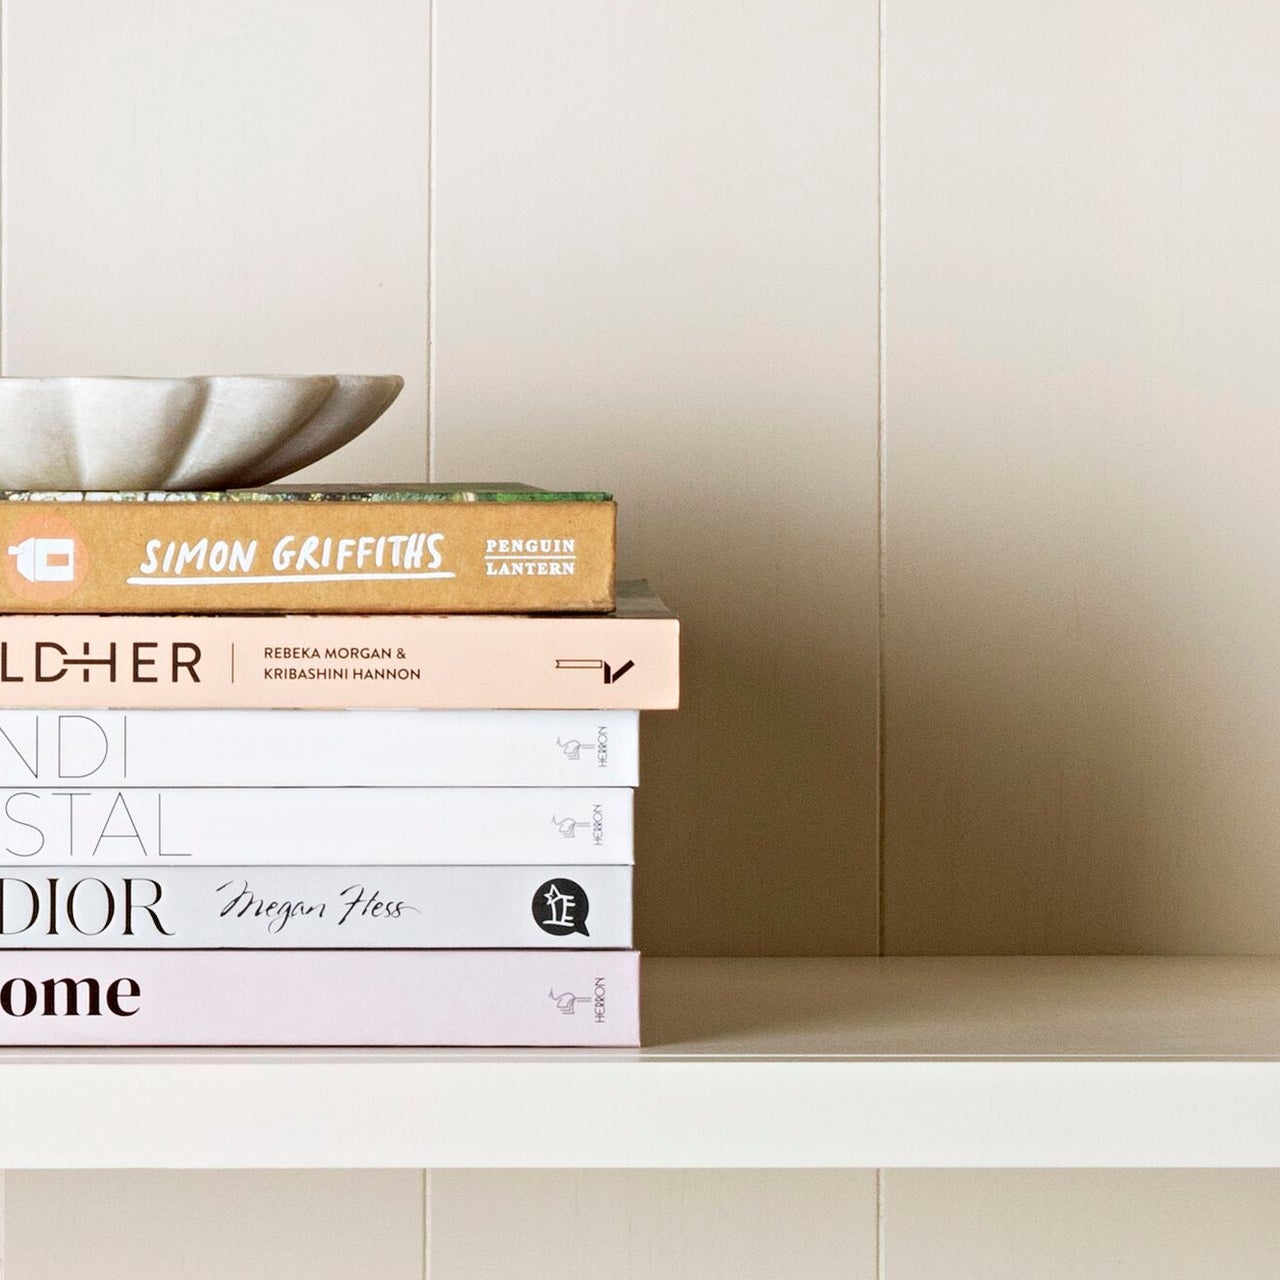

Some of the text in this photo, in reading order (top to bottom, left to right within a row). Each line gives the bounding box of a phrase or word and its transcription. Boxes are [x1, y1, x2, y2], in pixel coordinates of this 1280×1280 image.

[139, 532, 446, 575] SIMON GRIFFITHS
[485, 539, 576, 554] PENGUIN
[485, 561, 576, 576] LANTERN
[264, 647, 407, 660] REBEKA MORGAN &
[264, 668, 421, 681] KRIBASHINI HANNON
[215, 879, 421, 934] Megan Hess
